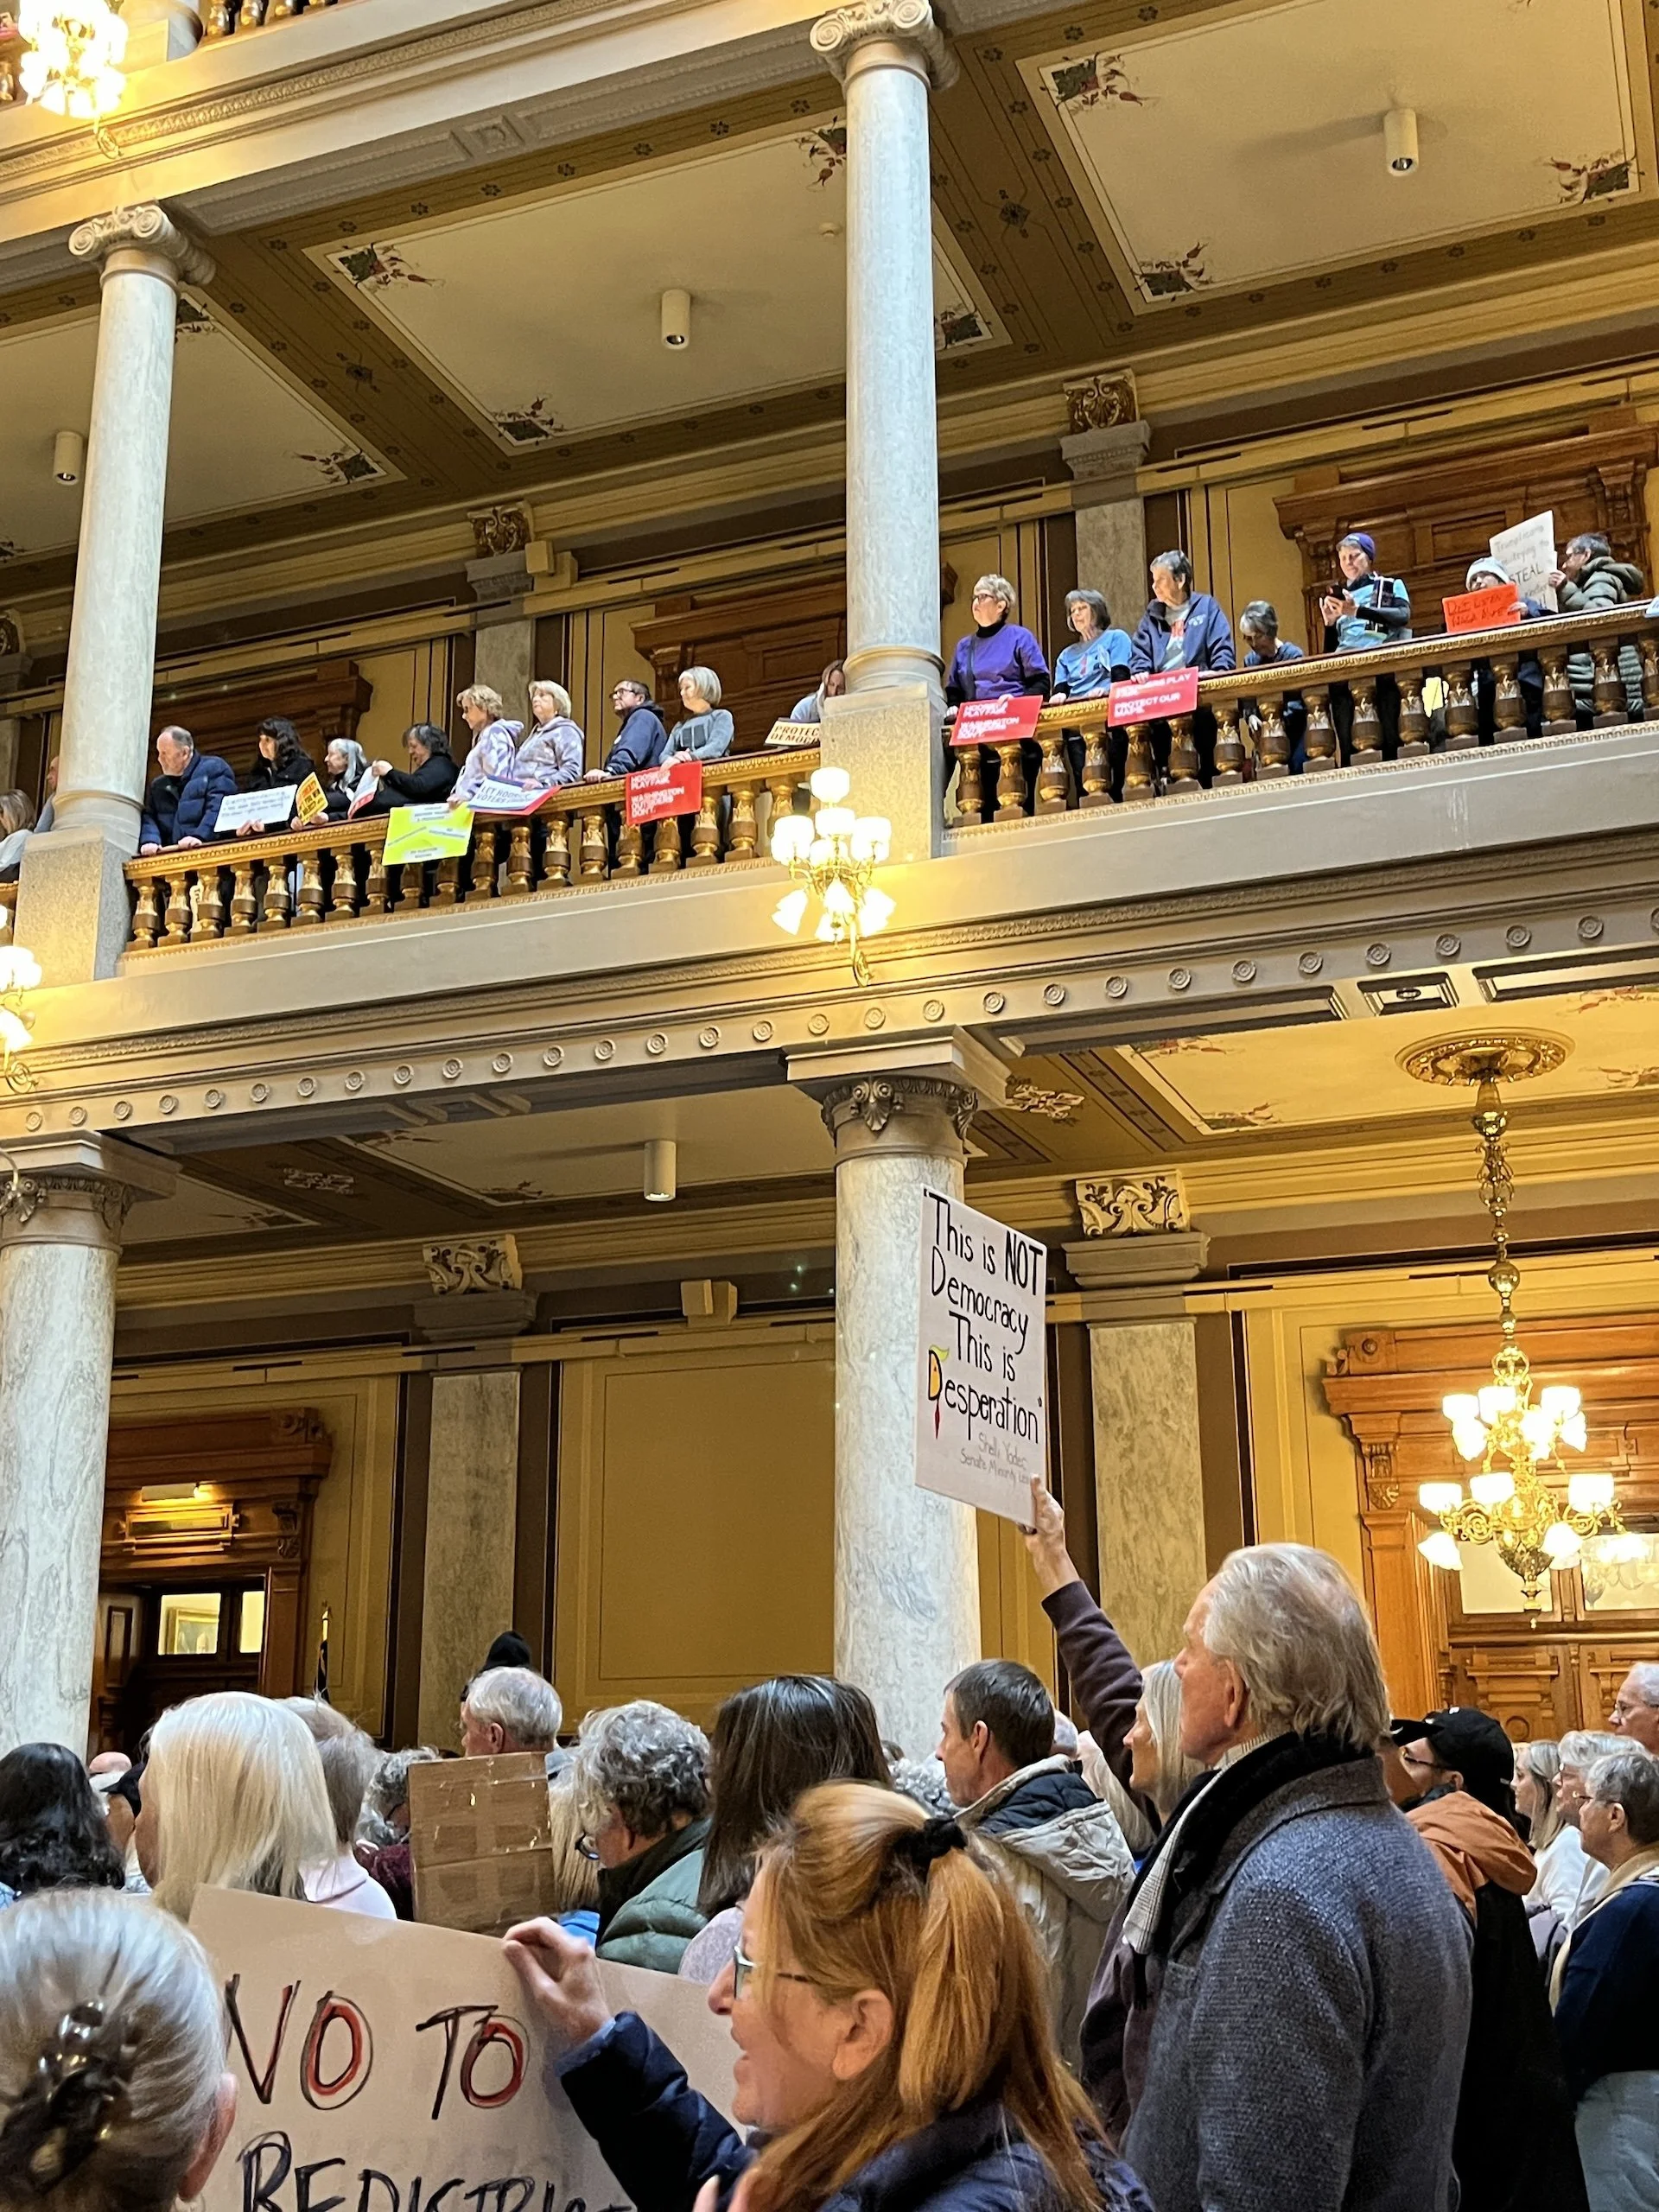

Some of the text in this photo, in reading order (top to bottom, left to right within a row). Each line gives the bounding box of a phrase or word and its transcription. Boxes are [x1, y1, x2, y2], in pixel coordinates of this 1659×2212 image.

[1509, 563, 1544, 586] STEAL
[1166, 673, 1192, 684] PLAY
[1159, 692, 1181, 703] OUR
[774, 725, 820, 736] PROTEC
[631, 785, 685, 803] WASHINGTON
[982, 1236, 996, 1275] is
[1005, 1230, 1044, 1296] NOT
[931, 1245, 1029, 1355] Democracy
[948, 1309, 1016, 1382] This is
[959, 1447, 987, 1470] Senate
[415, 2004, 531, 2121] TO
